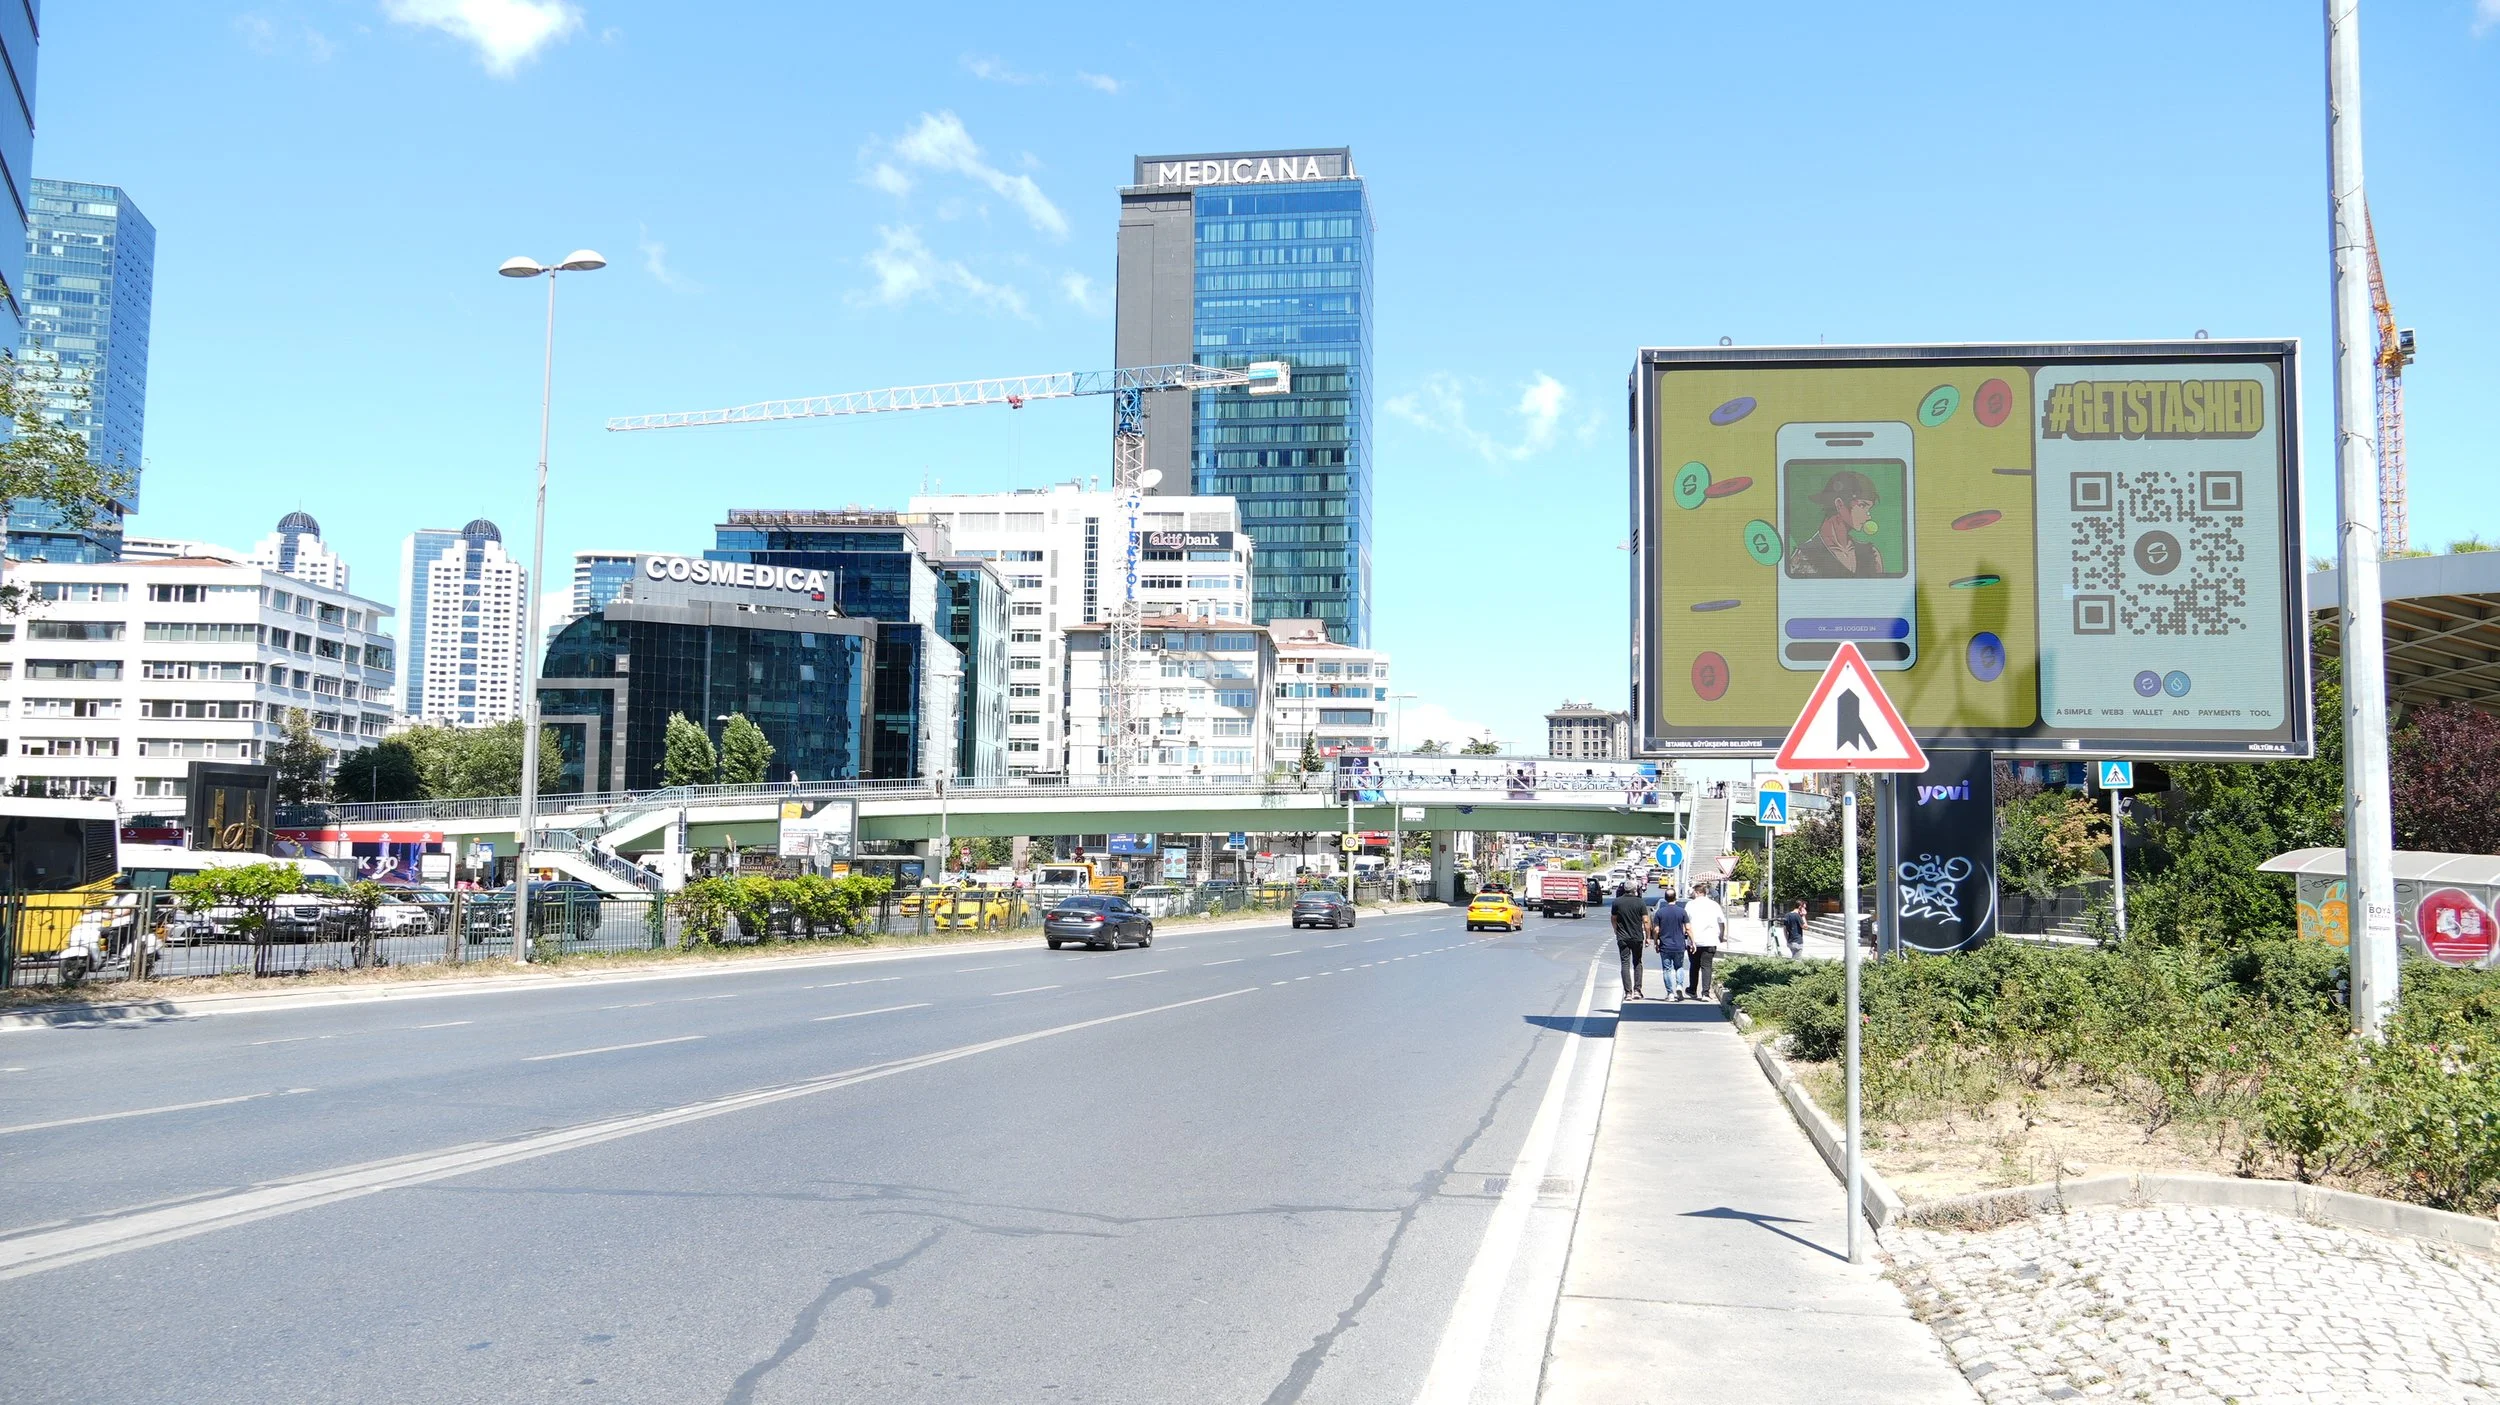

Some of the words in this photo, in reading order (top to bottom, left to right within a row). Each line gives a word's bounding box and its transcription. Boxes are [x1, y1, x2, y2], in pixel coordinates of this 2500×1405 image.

[1158, 155, 1321, 187] MEDICANA
[2043, 380, 2264, 440] #GETSTASHED
[1151, 533, 1183, 547] aktif
[1186, 533, 1219, 546] bank
[646, 556, 824, 592] COSMEDICA
[2064, 708, 2092, 716] SIMPLE
[2172, 709, 2190, 717] AND
[1917, 779, 1969, 806] yovi
[376, 856, 398, 870] 70
[2368, 906, 2391, 915] BOYA
